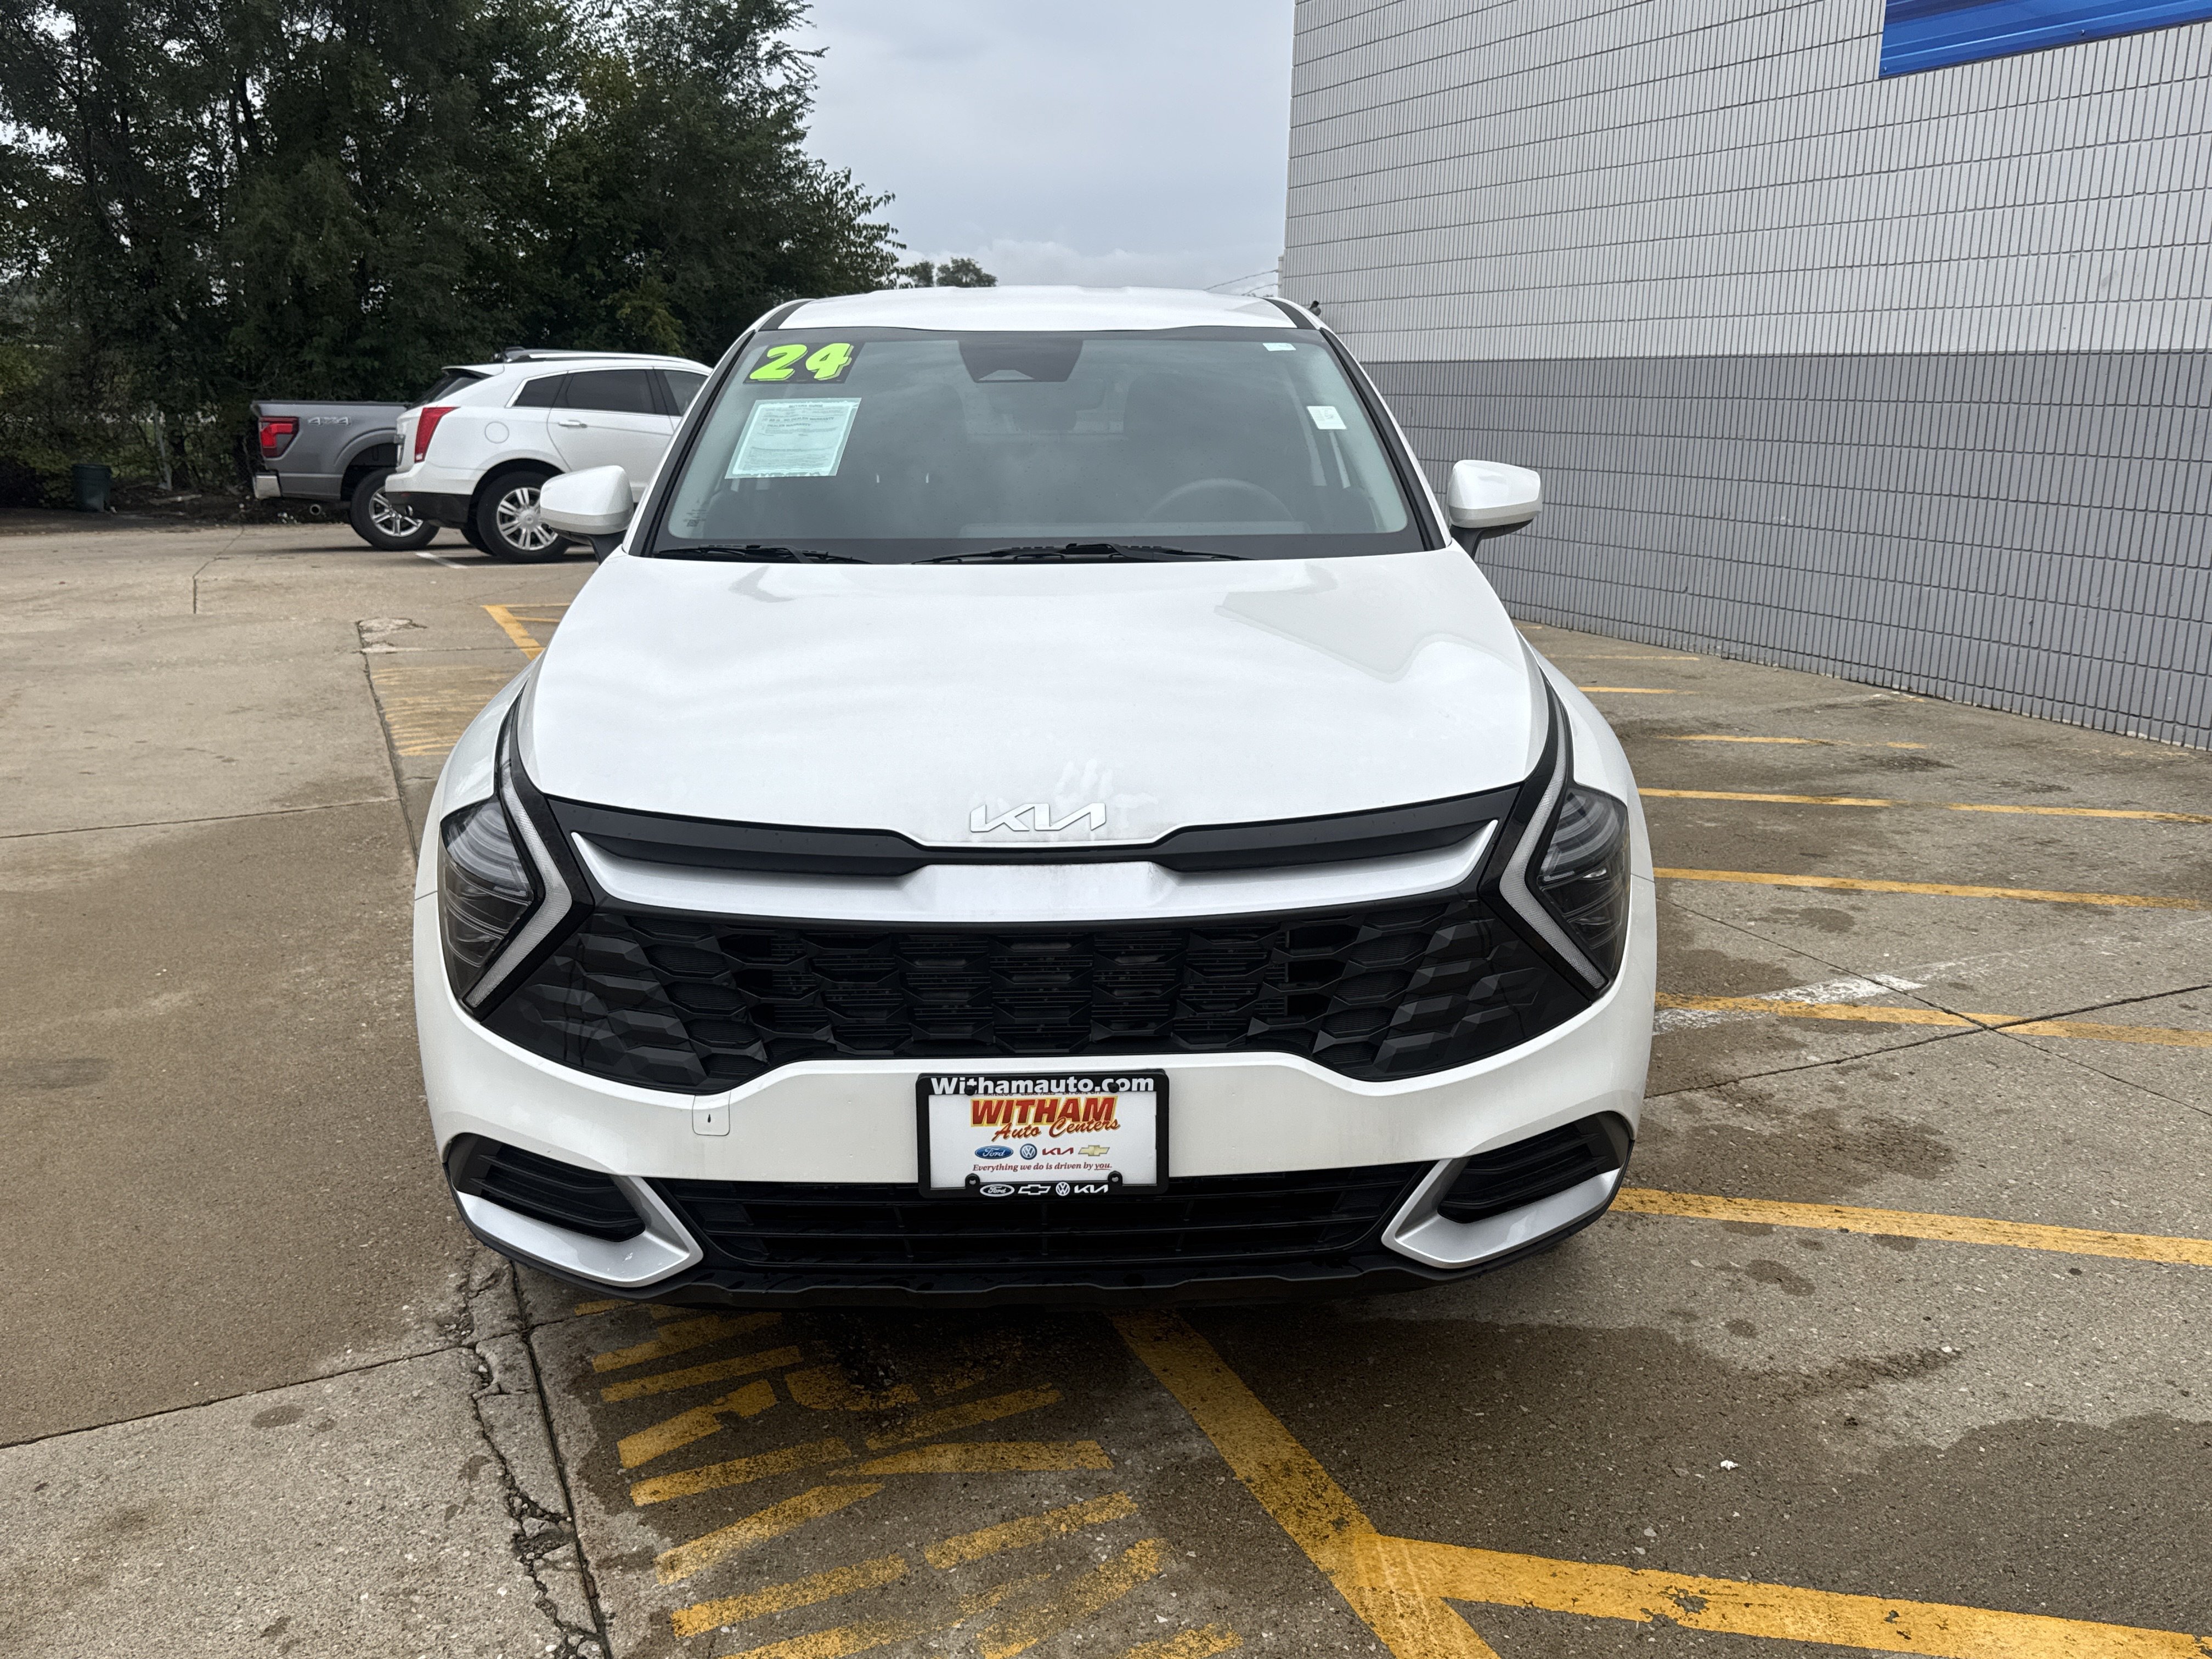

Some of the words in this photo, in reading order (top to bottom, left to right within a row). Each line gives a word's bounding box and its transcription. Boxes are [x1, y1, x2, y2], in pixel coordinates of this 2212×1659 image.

[749, 343, 854, 381] 24
[970, 803, 1107, 832] KIA
[970, 1096, 1117, 1127] WITHAM
[991, 1122, 1041, 1142] Auto
[1049, 1117, 1120, 1138] Centers
[982, 1147, 1006, 1157] Ford
[1042, 1147, 1074, 1155] KIA
[973, 1164, 1019, 1172] Everything
[1083, 1161, 1093, 1171] by
[987, 1185, 1007, 1194] Ford
[1074, 1184, 1109, 1193] KIA
